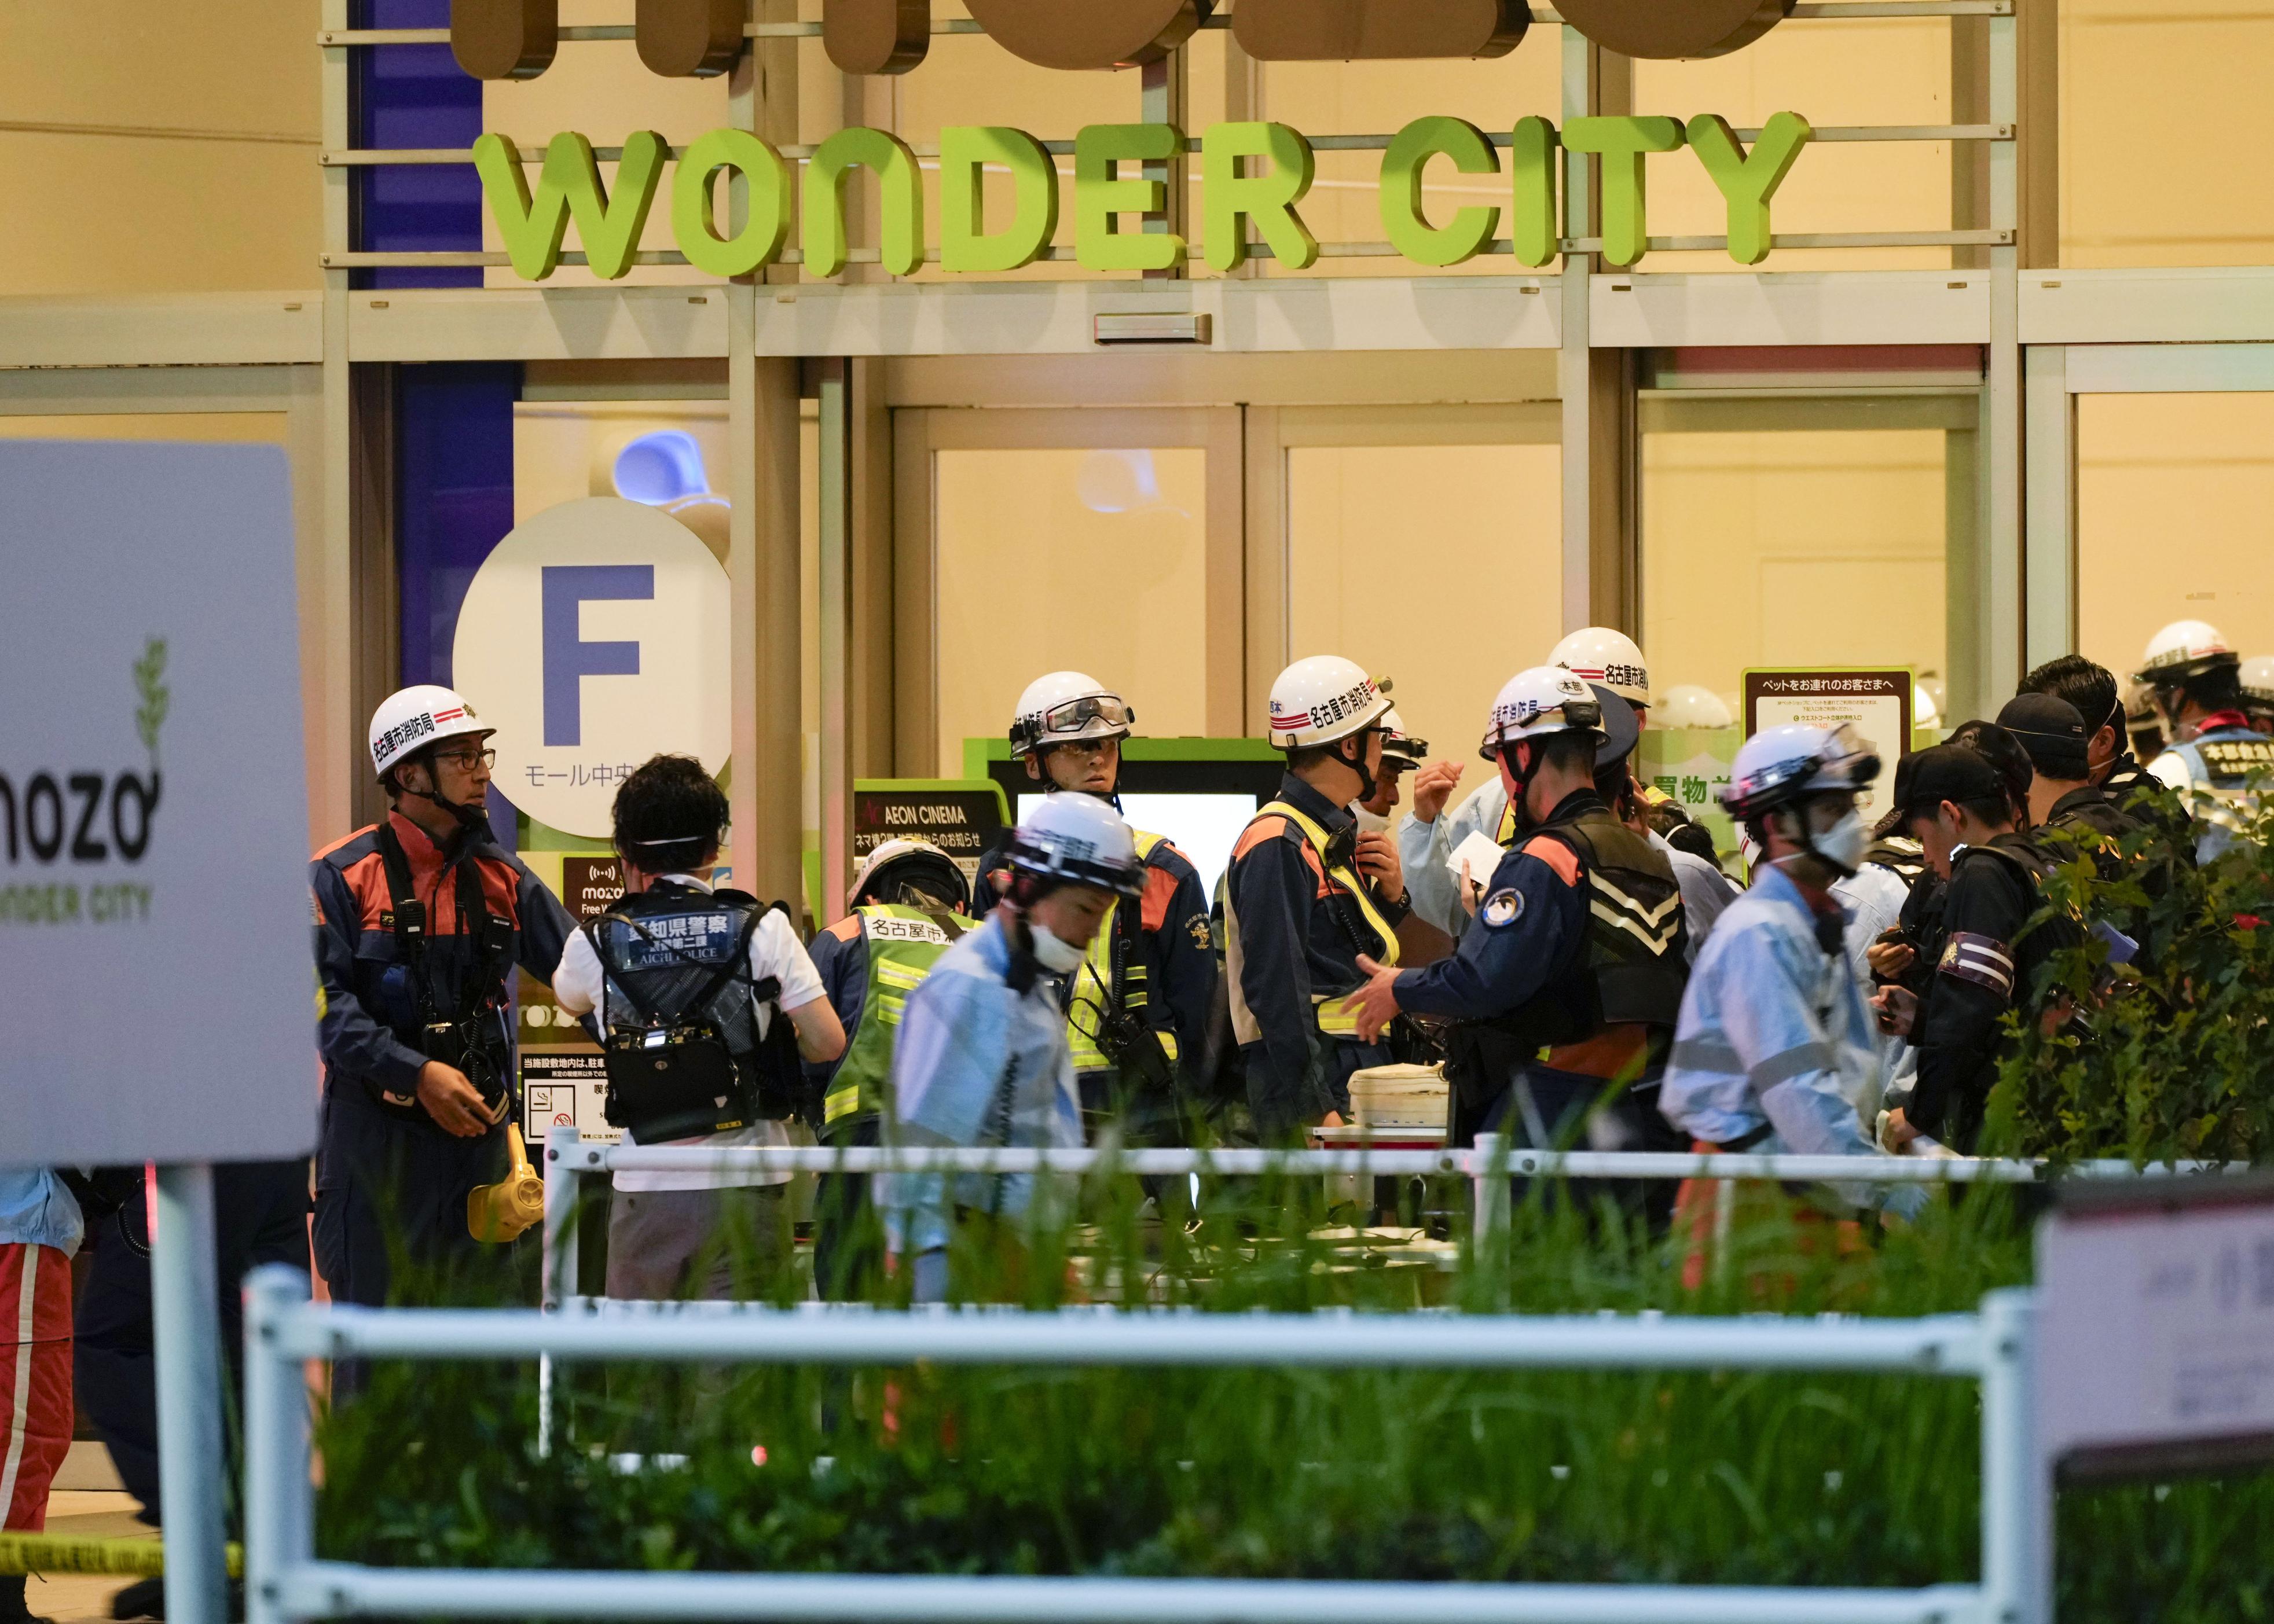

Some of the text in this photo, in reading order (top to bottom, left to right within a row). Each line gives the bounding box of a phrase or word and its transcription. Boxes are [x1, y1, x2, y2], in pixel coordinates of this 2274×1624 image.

[1380, 111, 1810, 267] CITY
[541, 565, 654, 747] F
[1560, 681, 1582, 692] 本部
[1763, 679, 1894, 692] ペットをお連れのお客さまへ
[1311, 682, 1373, 729] 名古屋市消防局
[374, 712, 435, 763] 名古屋市消防局
[526, 763, 647, 787] モール中央
[885, 806, 918, 825] AEON
[919, 806, 967, 824] CINEMA
[582, 888, 625, 899] mozo
[582, 904, 600, 914] Free
[872, 919, 952, 943] 名古屋市
[640, 948, 717, 965] AICHI OLICE
